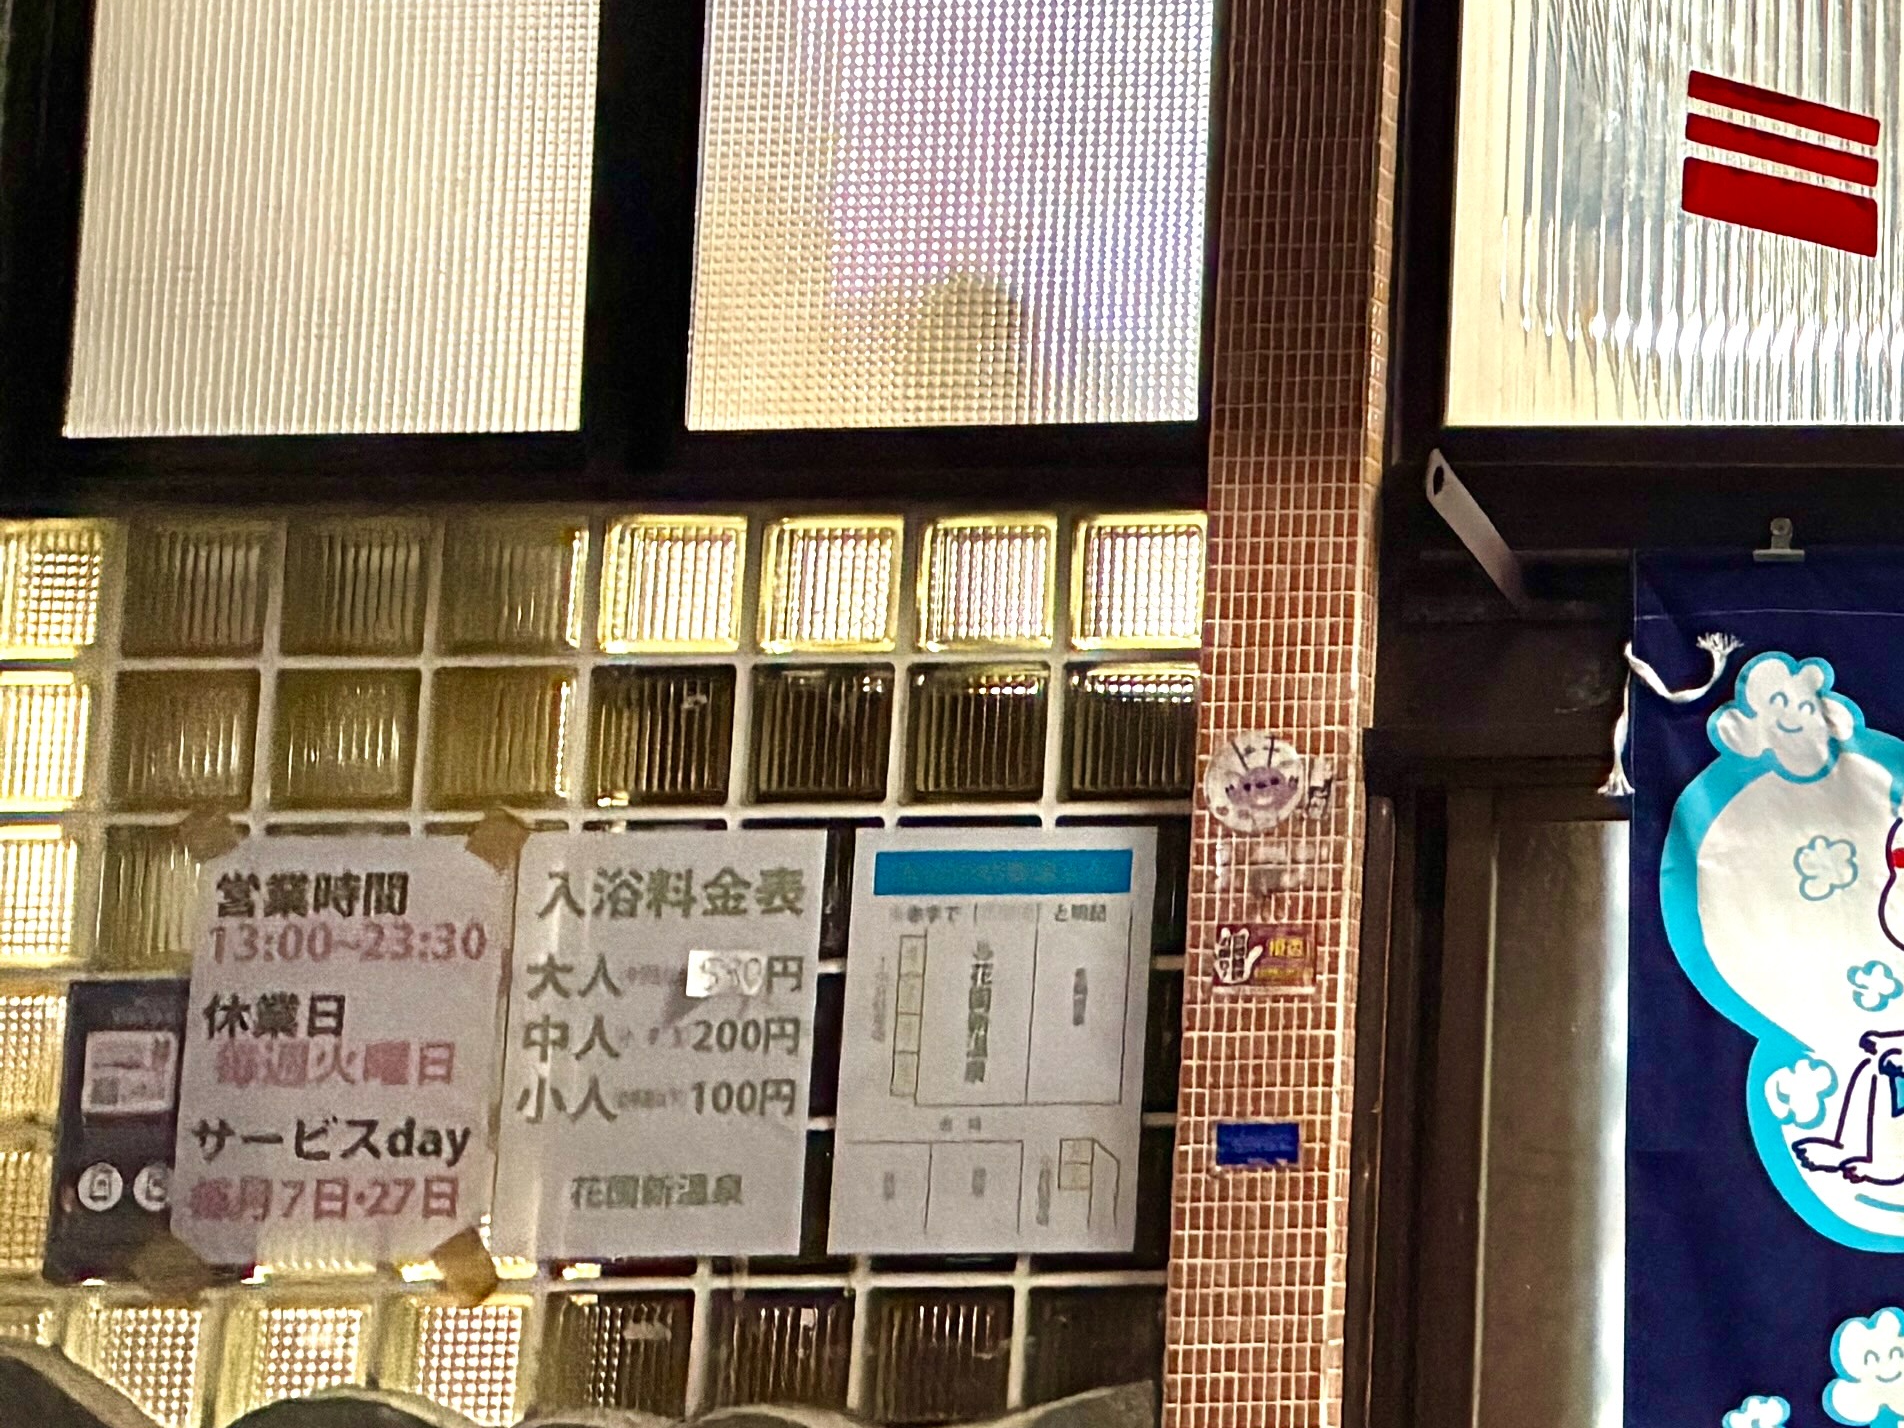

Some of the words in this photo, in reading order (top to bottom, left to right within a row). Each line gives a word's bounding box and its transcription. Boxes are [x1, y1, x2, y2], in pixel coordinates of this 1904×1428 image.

[215, 872, 409, 919] 営業時間
[537, 868, 805, 921] 入浴料金表
[526, 953, 622, 1000] 大人
[203, 993, 346, 1039] 休業日
[522, 1014, 620, 1063] 中人
[691, 1016, 801, 1057] 200円
[516, 1074, 618, 1123] 小人
[690, 1078, 797, 1117] 100円
[192, 1117, 472, 1165] サービスday
